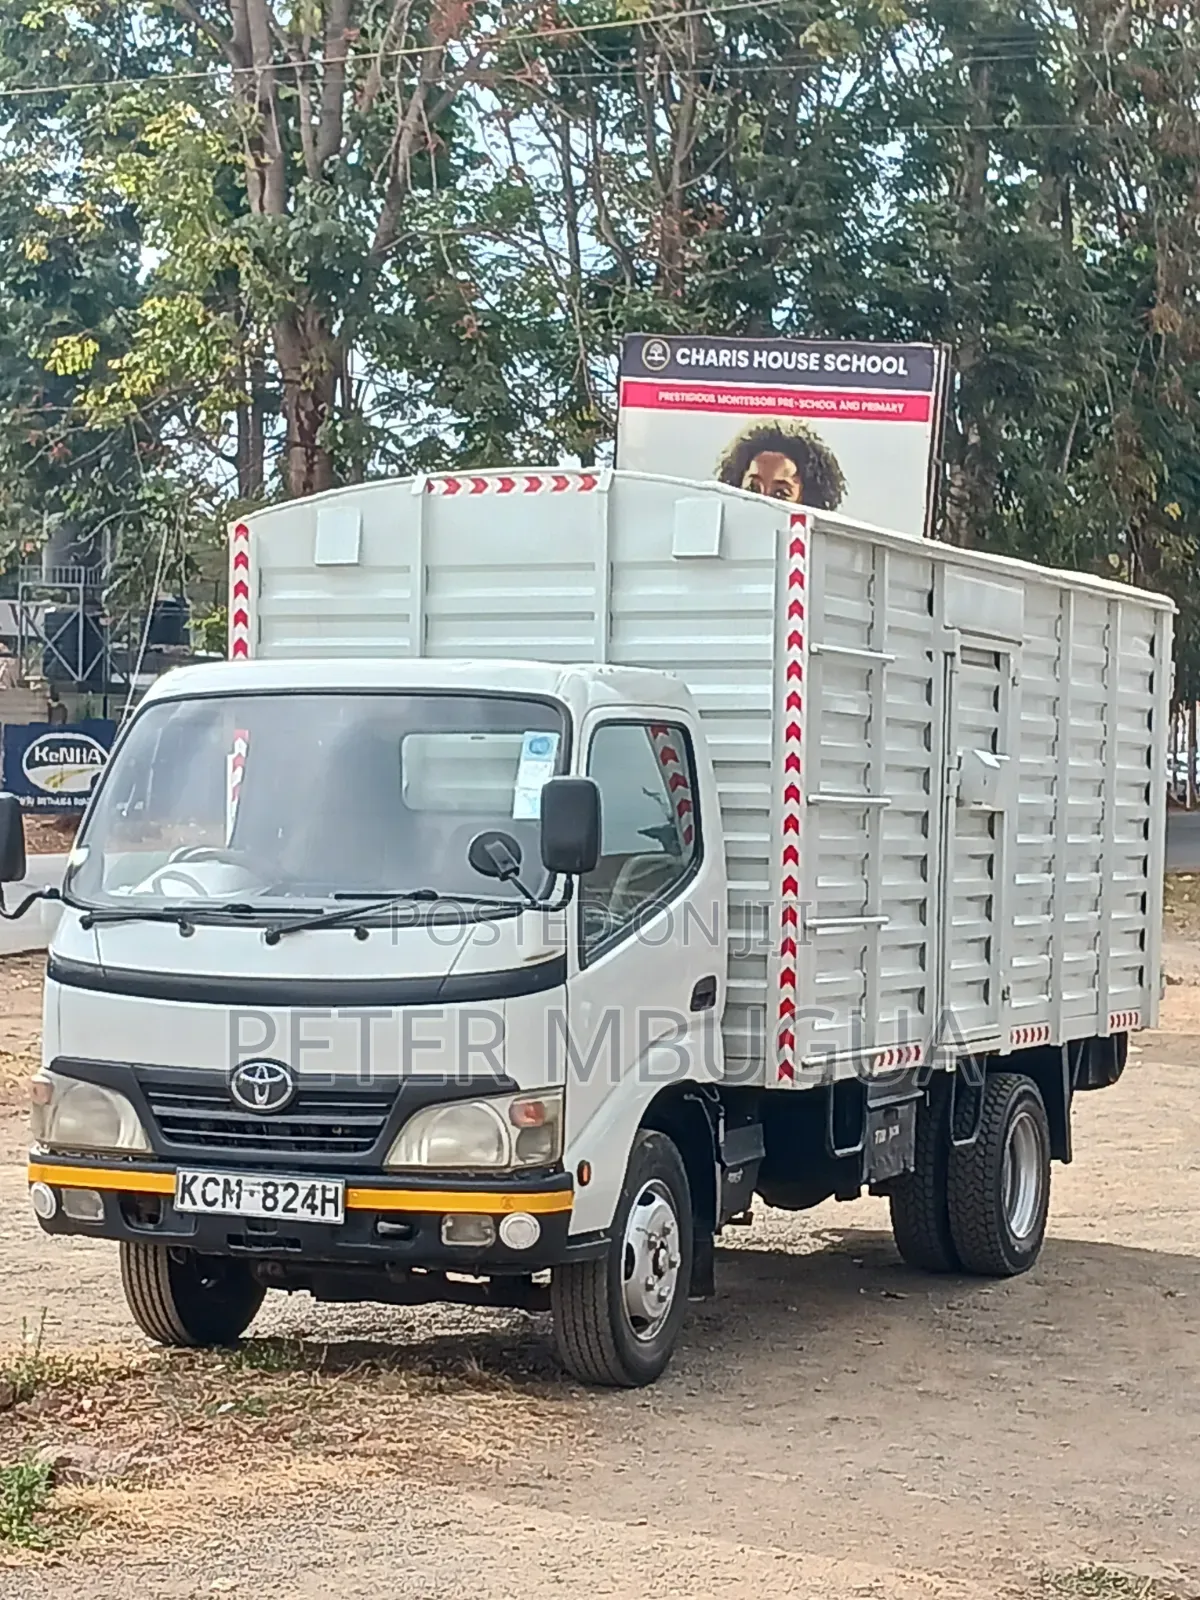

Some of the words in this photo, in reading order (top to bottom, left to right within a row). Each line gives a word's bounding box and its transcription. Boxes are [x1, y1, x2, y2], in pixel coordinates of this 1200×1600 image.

[676, 348, 749, 368] CHARIS
[753, 351, 820, 371] HOUSE
[824, 353, 908, 375] SCHOOL
[658, 391, 716, 403] PRESTIGIOUS
[839, 400, 860, 411] AND
[861, 401, 904, 413] PRIMARY
[34, 746, 102, 764] KeNHA
[262, 1181, 339, 1217] 824H
